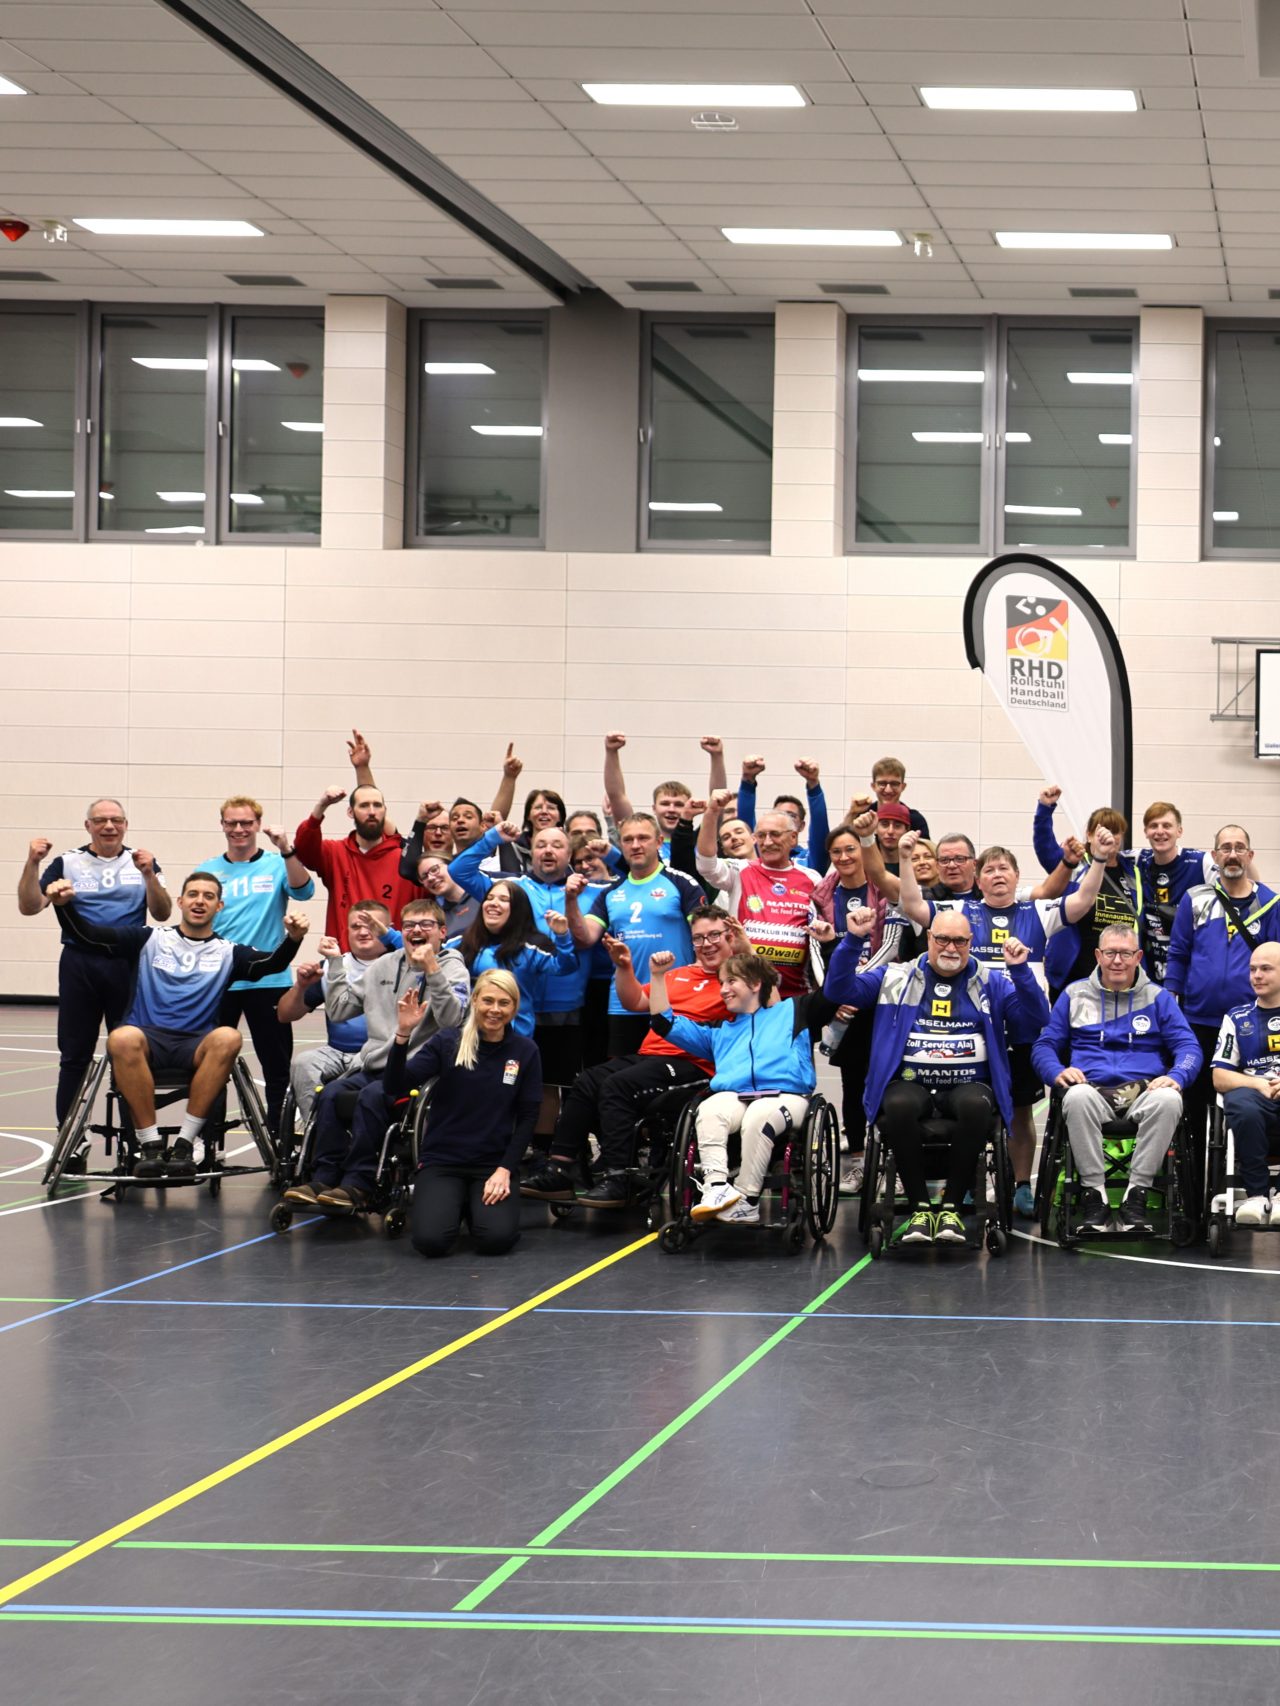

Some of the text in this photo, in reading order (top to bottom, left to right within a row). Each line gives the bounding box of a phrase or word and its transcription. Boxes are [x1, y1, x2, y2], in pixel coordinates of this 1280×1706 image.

[1010, 658, 1063, 679] RHD
[1010, 676, 1065, 689] Rollstuhl
[1010, 687, 1064, 700] Handball
[1010, 697, 1066, 709] Deutschland
[102, 868, 115, 888] 8
[230, 876, 249, 896] 11
[382, 884, 393, 899] 2
[630, 901, 643, 923] 2
[995, 931, 1005, 939] H
[181, 952, 196, 972] 9
[935, 1004, 947, 1013] H
[914, 1018, 976, 1028] SSELMANN
[922, 1040, 955, 1049] Service
[957, 1039, 973, 1050] Alaj
[918, 1068, 976, 1076] MANTOS
